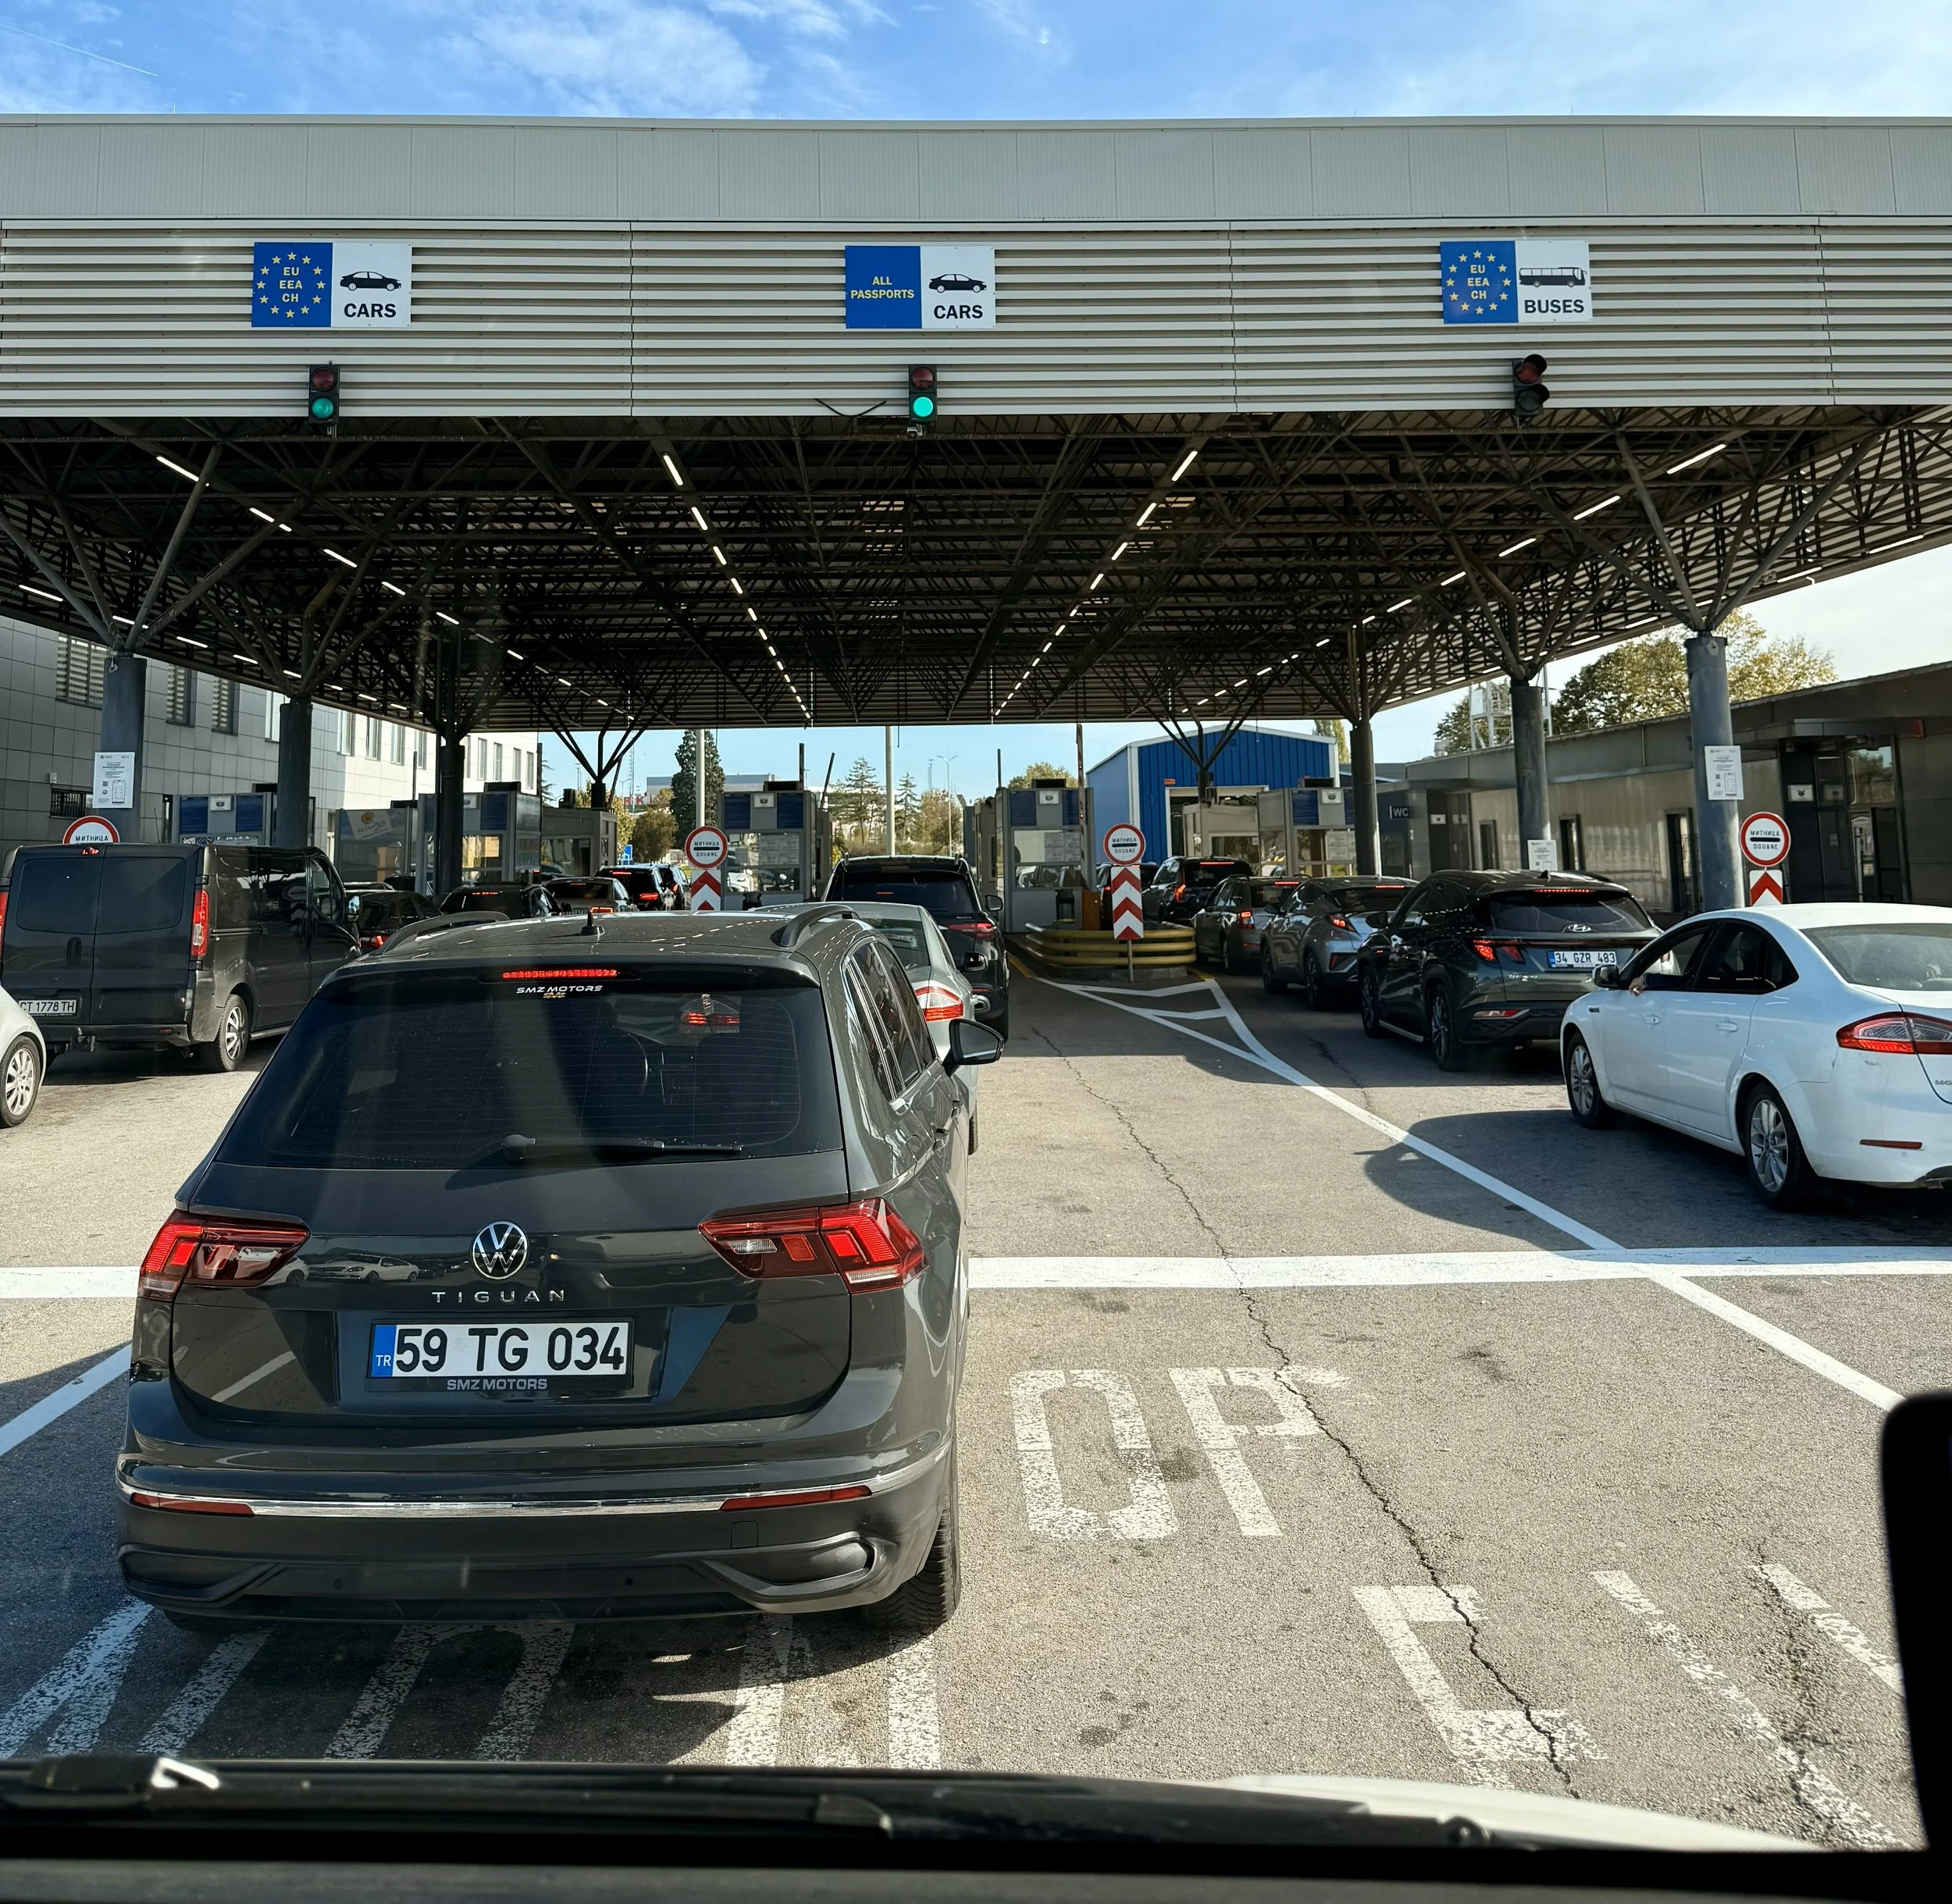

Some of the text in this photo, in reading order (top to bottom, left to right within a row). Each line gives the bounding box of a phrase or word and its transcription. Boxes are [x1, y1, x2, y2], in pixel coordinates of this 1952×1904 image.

[283, 267, 300, 276] EU
[1470, 265, 1485, 273] EU
[279, 279, 303, 289] EEA
[872, 276, 892, 286] ALL
[1467, 277, 1490, 286] EEA
[282, 293, 299, 303] CH
[850, 289, 914, 299] PASSPORTS
[1471, 290, 1487, 300] CH
[344, 303, 397, 318] CARS
[934, 304, 983, 319] CARS
[1524, 299, 1584, 314] BUSES
[1393, 807, 1409, 817] WC
[1555, 952, 1615, 963] 34 GZR 483
[36, 1002, 59, 1013] 1778
[62, 1002, 75, 1013] TH
[431, 1290, 565, 1303] TIGUAN
[396, 1326, 625, 1372] 59 TG 034
[376, 1354, 391, 1367] TR
[447, 1379, 547, 1390] SMZ MOTORS
